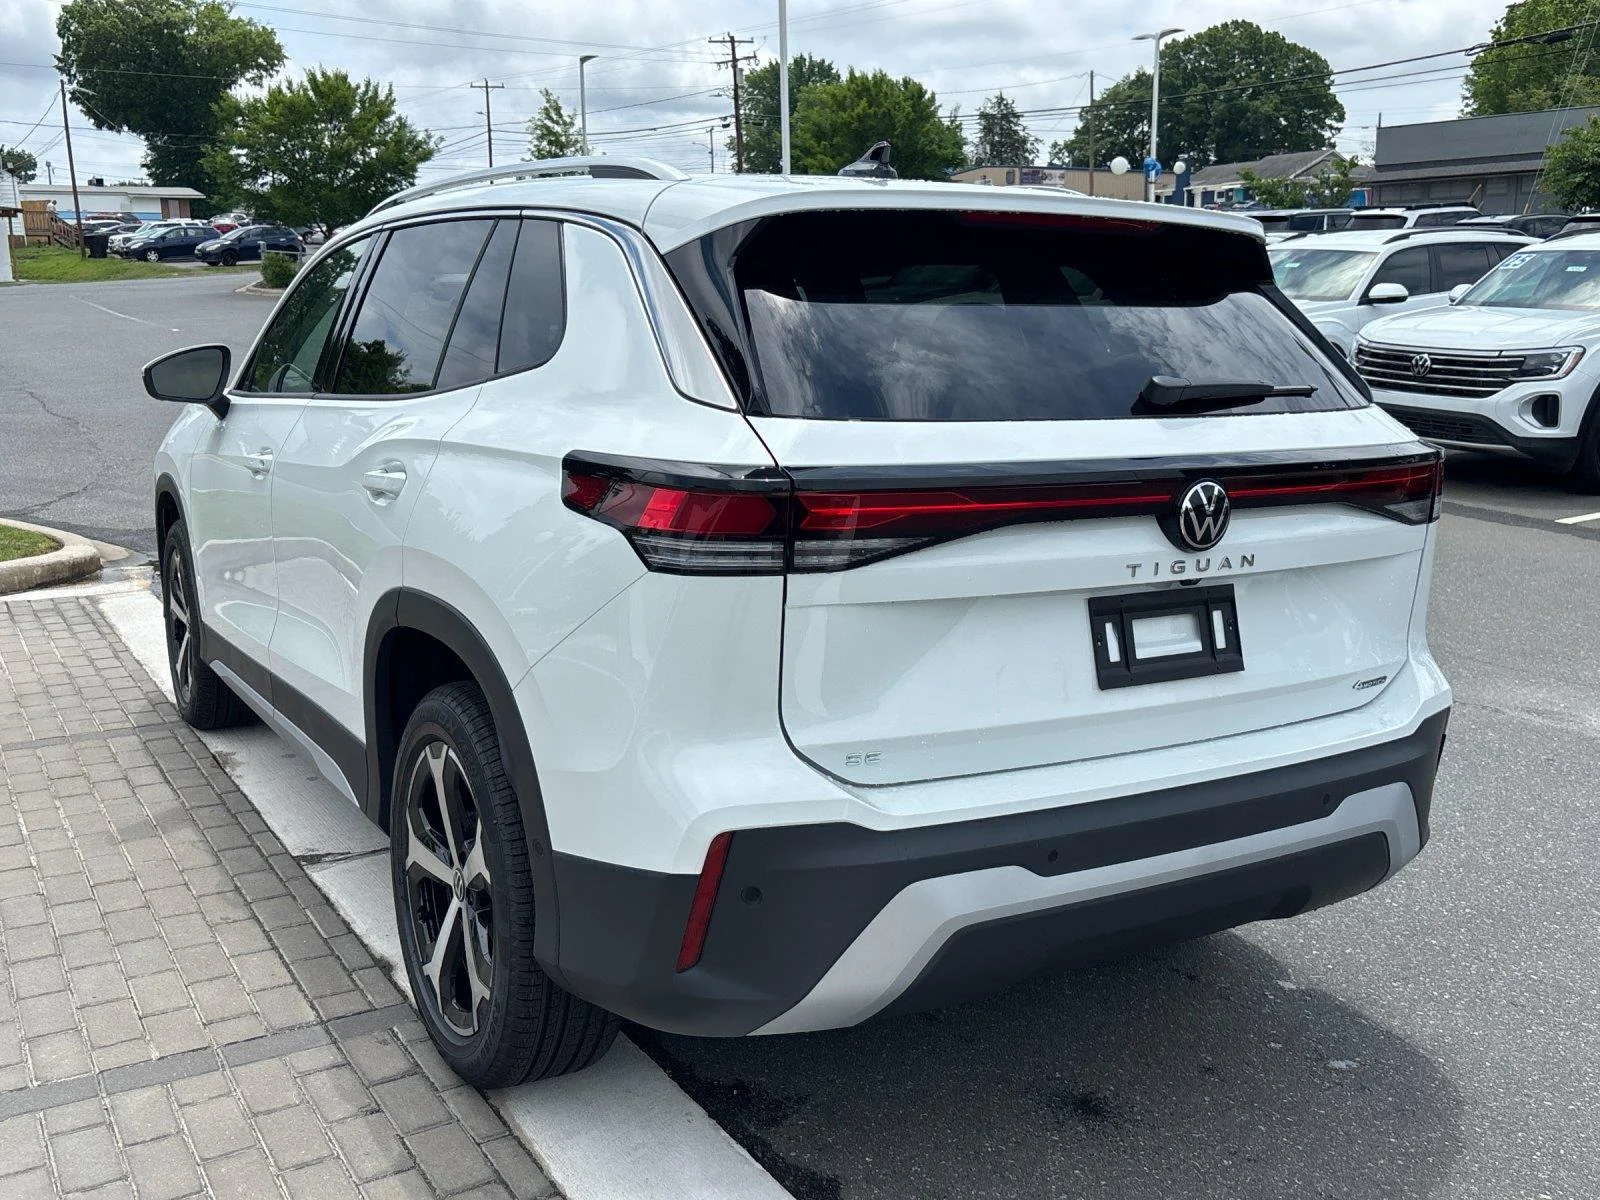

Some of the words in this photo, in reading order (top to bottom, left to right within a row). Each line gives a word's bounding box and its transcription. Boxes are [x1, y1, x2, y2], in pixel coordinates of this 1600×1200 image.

[1180, 481, 1230, 549] VW
[1126, 553, 1255, 578] TIGUAN
[844, 750, 882, 766] SE
